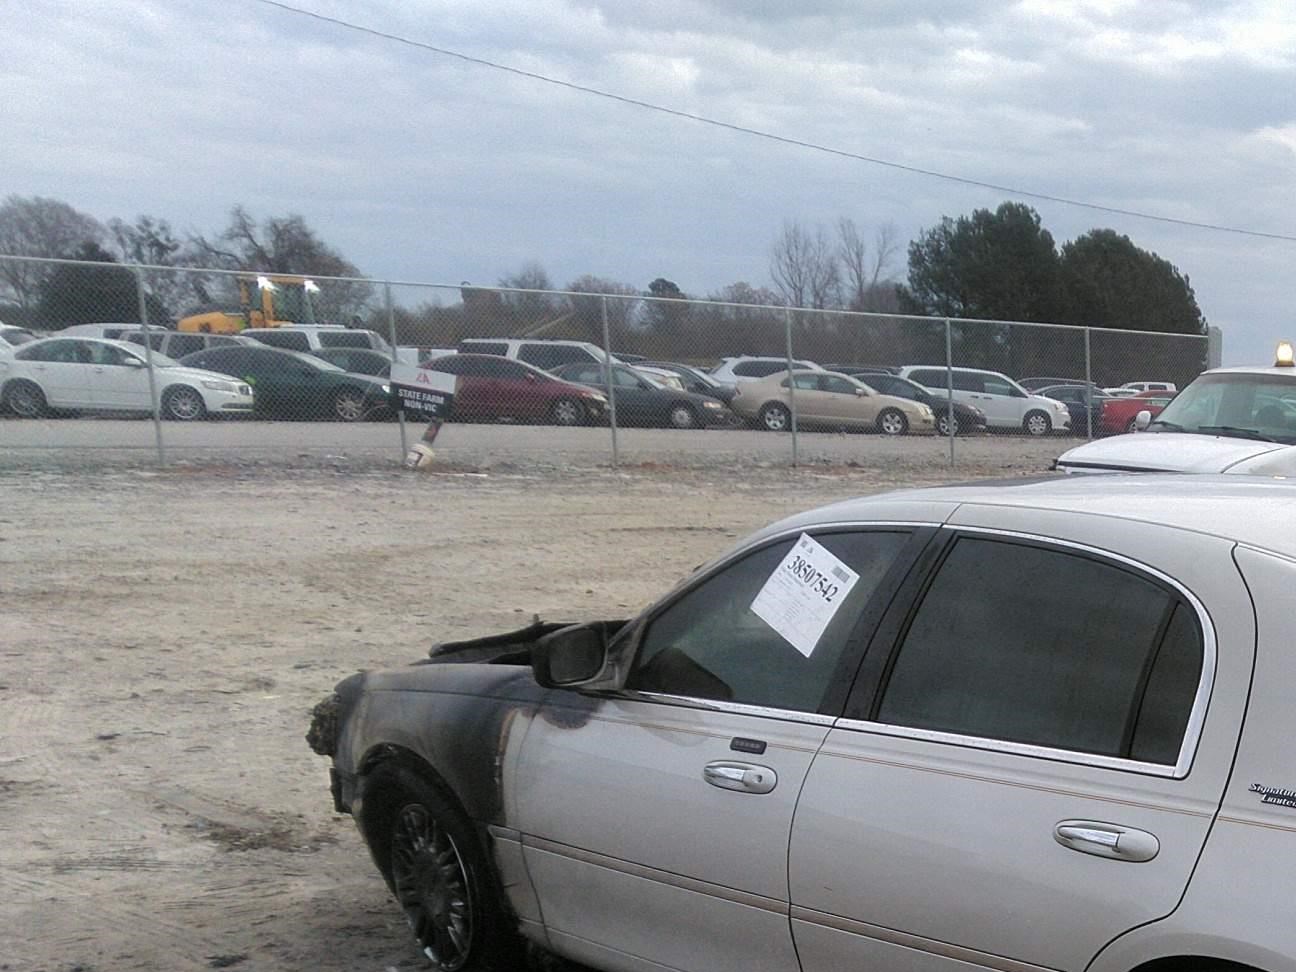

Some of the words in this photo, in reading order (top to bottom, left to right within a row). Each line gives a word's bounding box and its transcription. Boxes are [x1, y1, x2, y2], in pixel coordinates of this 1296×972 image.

[398, 388, 421, 401] STATE
[422, 393, 445, 405] FARM
[403, 399, 438, 413] NON-VIC
[787, 555, 838, 603] 38507542
